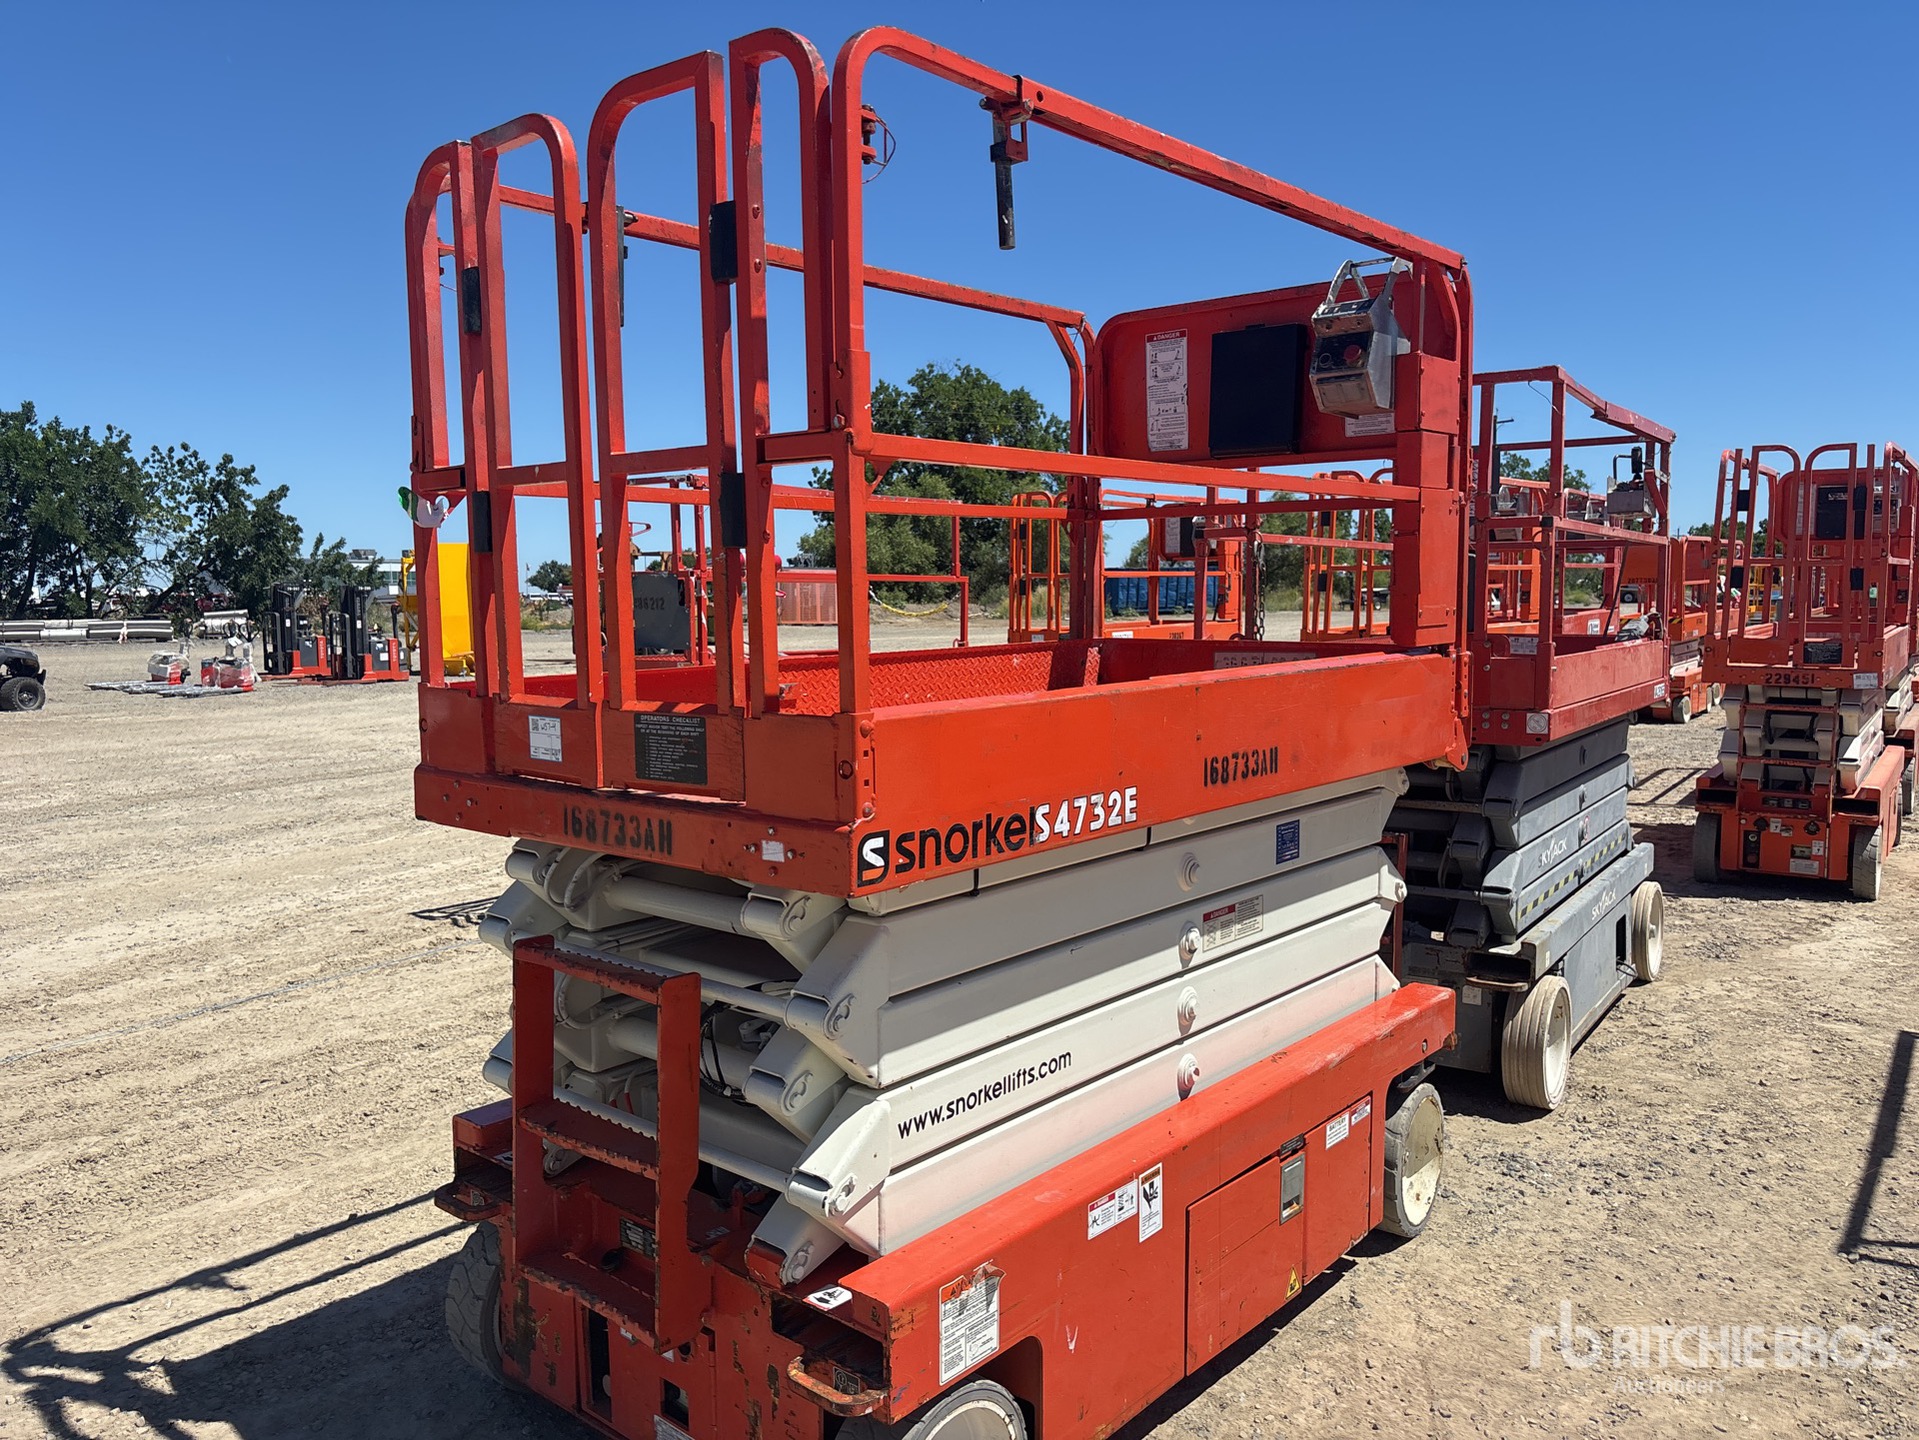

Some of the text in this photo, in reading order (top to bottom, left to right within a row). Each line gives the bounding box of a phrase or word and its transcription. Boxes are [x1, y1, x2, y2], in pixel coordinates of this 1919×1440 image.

[1157, 331, 1180, 341] DANGER
[895, 806, 1036, 874] snorkel
[1034, 786, 1138, 843] S4732E
[1538, 835, 1568, 868] SKYJACK
[1592, 887, 1617, 920] SKYJACK
[897, 1051, 1073, 1140] www.snorkellifts.com
